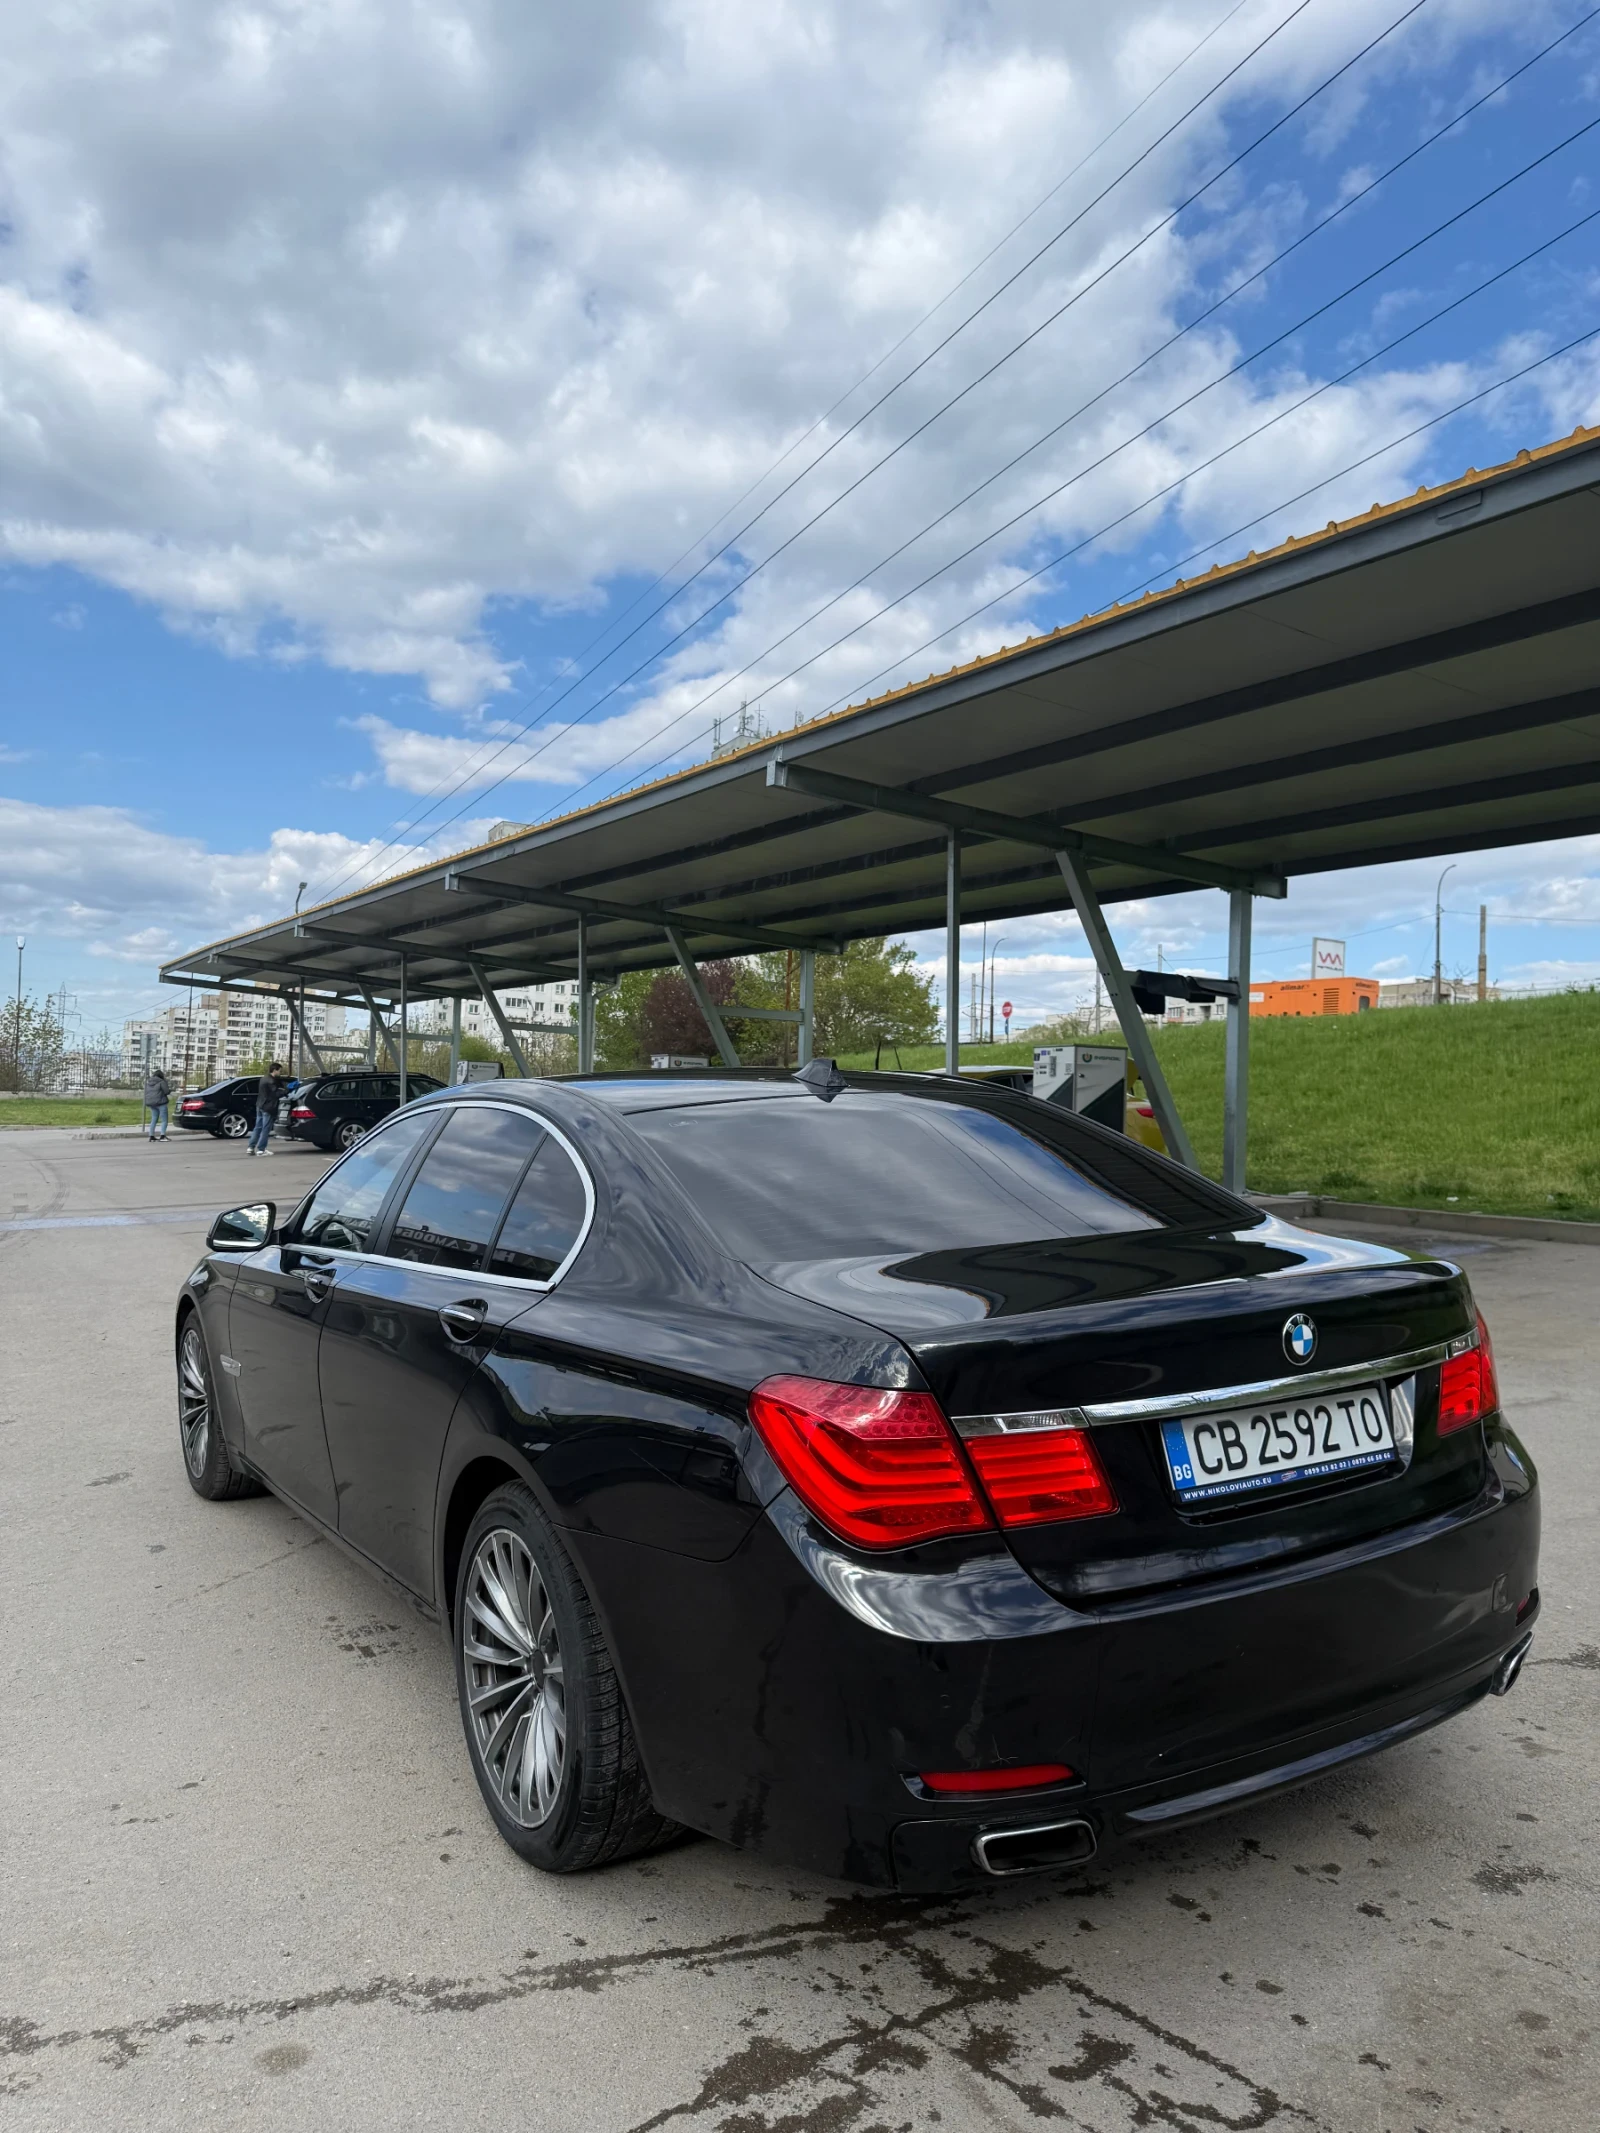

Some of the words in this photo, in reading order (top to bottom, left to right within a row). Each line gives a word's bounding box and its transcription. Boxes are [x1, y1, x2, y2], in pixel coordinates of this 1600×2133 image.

[1286, 1315, 1315, 1333] BMW
[1193, 1420, 1248, 1475] CB
[1251, 1404, 1340, 1465] 2592
[1337, 1397, 1383, 1447] TO
[1173, 1464, 1192, 1481] BG
[1304, 1467, 1320, 1475] 0899
[1184, 1476, 1272, 1500] WWW.NIKOLOVIAUTO.EU
